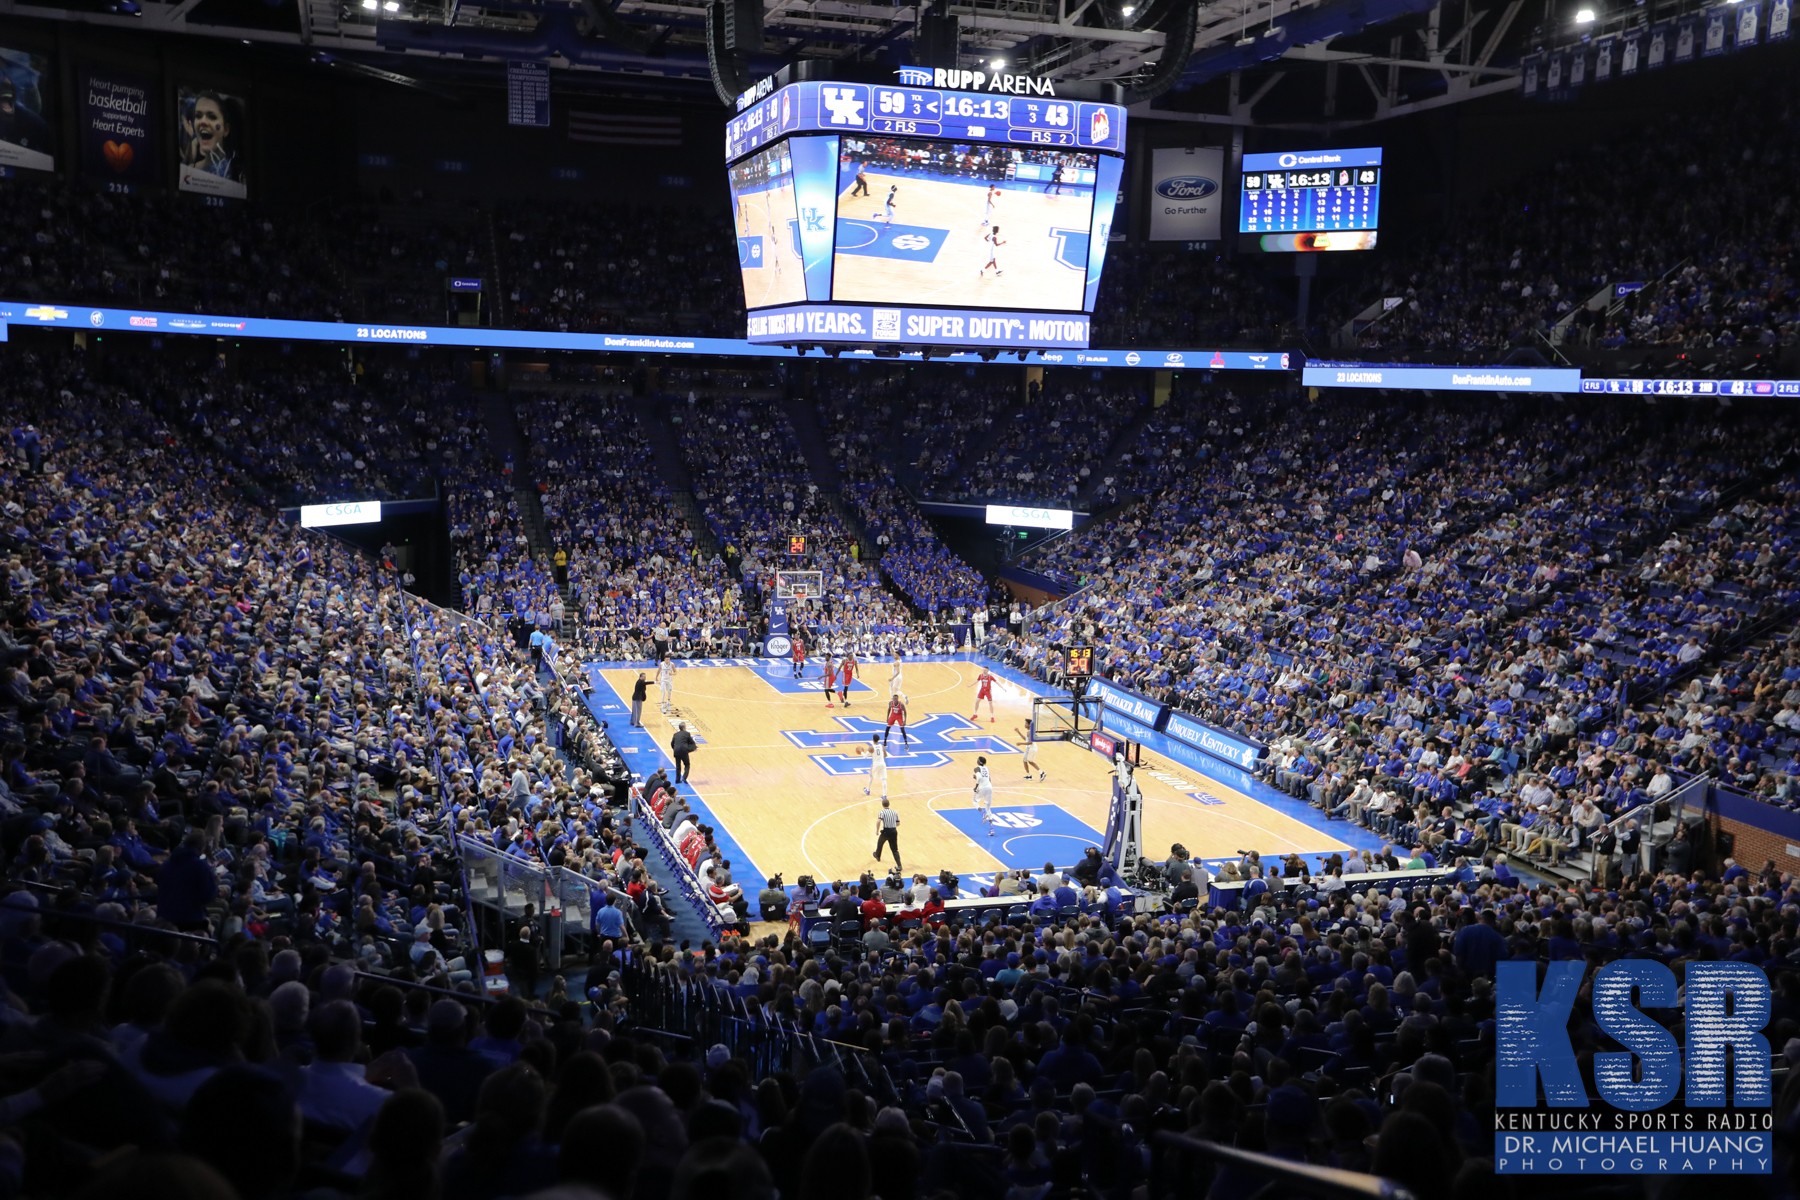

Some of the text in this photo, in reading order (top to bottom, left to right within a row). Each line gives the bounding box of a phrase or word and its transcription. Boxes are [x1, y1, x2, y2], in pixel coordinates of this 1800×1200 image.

[89, 77, 144, 99] Heart pumping
[756, 75, 773, 101] ARENA
[934, 68, 1055, 96] RUPP ARENA
[88, 90, 147, 115] basketball
[880, 91, 1068, 126] 59 3 16:13 3 43
[102, 111, 134, 123] supported by
[92, 119, 145, 138] Heart Experts
[884, 121, 916, 133] 2 FLS
[1032, 132, 1066, 144] FLS 2
[1298, 156, 1323, 164] Central
[1246, 176, 1261, 188] 59
[1290, 173, 1330, 187] 16:13
[1360, 171, 1375, 183] 43
[109, 183, 129, 194] 236
[1167, 180, 1205, 196] Ford
[206, 197, 224, 207] 236
[1178, 206, 1207, 214] Further
[1188, 242, 1207, 250] 244
[130, 316, 157, 327] GMC
[796, 312, 804, 333] 40
[806, 312, 866, 334] YEARS.
[357, 328, 427, 340] 23 LOCATIONS
[907, 315, 965, 338] SUPER
[1029, 319, 1084, 341] MOTOR
[604, 338, 695, 348] DonFranklinAuto.com
[1041, 353, 1063, 362] Jeep
[1336, 372, 1382, 383] 23 LOCATIONS
[1452, 374, 1532, 386] DonFranklinAuto.com
[1632, 382, 1643, 392] 59
[1659, 381, 1693, 394] 16:13
[1731, 382, 1744, 394] 43
[326, 504, 362, 516] CSGA
[1012, 508, 1051, 520] CSGA
[790, 543, 804, 553] 29
[775, 606, 785, 615] UK
[771, 640, 788, 653] Kroger
[1071, 648, 1090, 658] 16:13
[1070, 658, 1088, 673] 29
[1100, 686, 1155, 722] WHITAKER BANK
[1168, 716, 1200, 742] UNIQUELY
[1200, 731, 1240, 759] KENTUCKY
